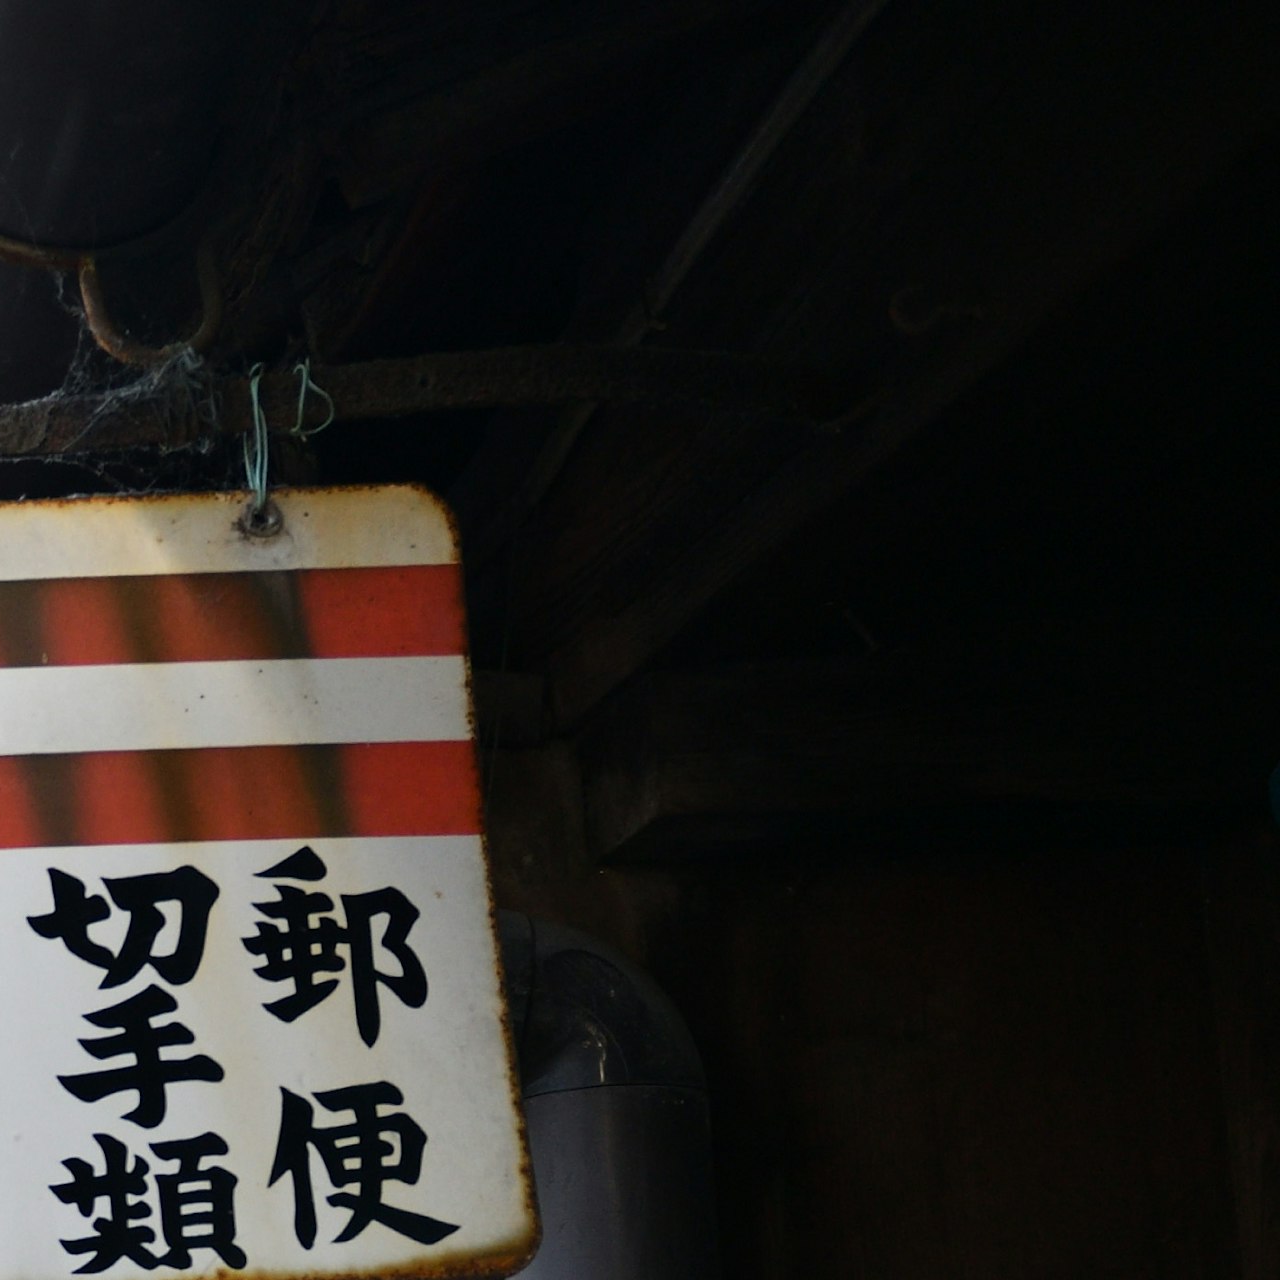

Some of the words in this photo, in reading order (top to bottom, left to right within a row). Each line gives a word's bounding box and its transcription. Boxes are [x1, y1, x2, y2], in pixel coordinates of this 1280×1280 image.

[29, 864, 246, 1275] 切手類
[241, 846, 461, 1250] 郵便
